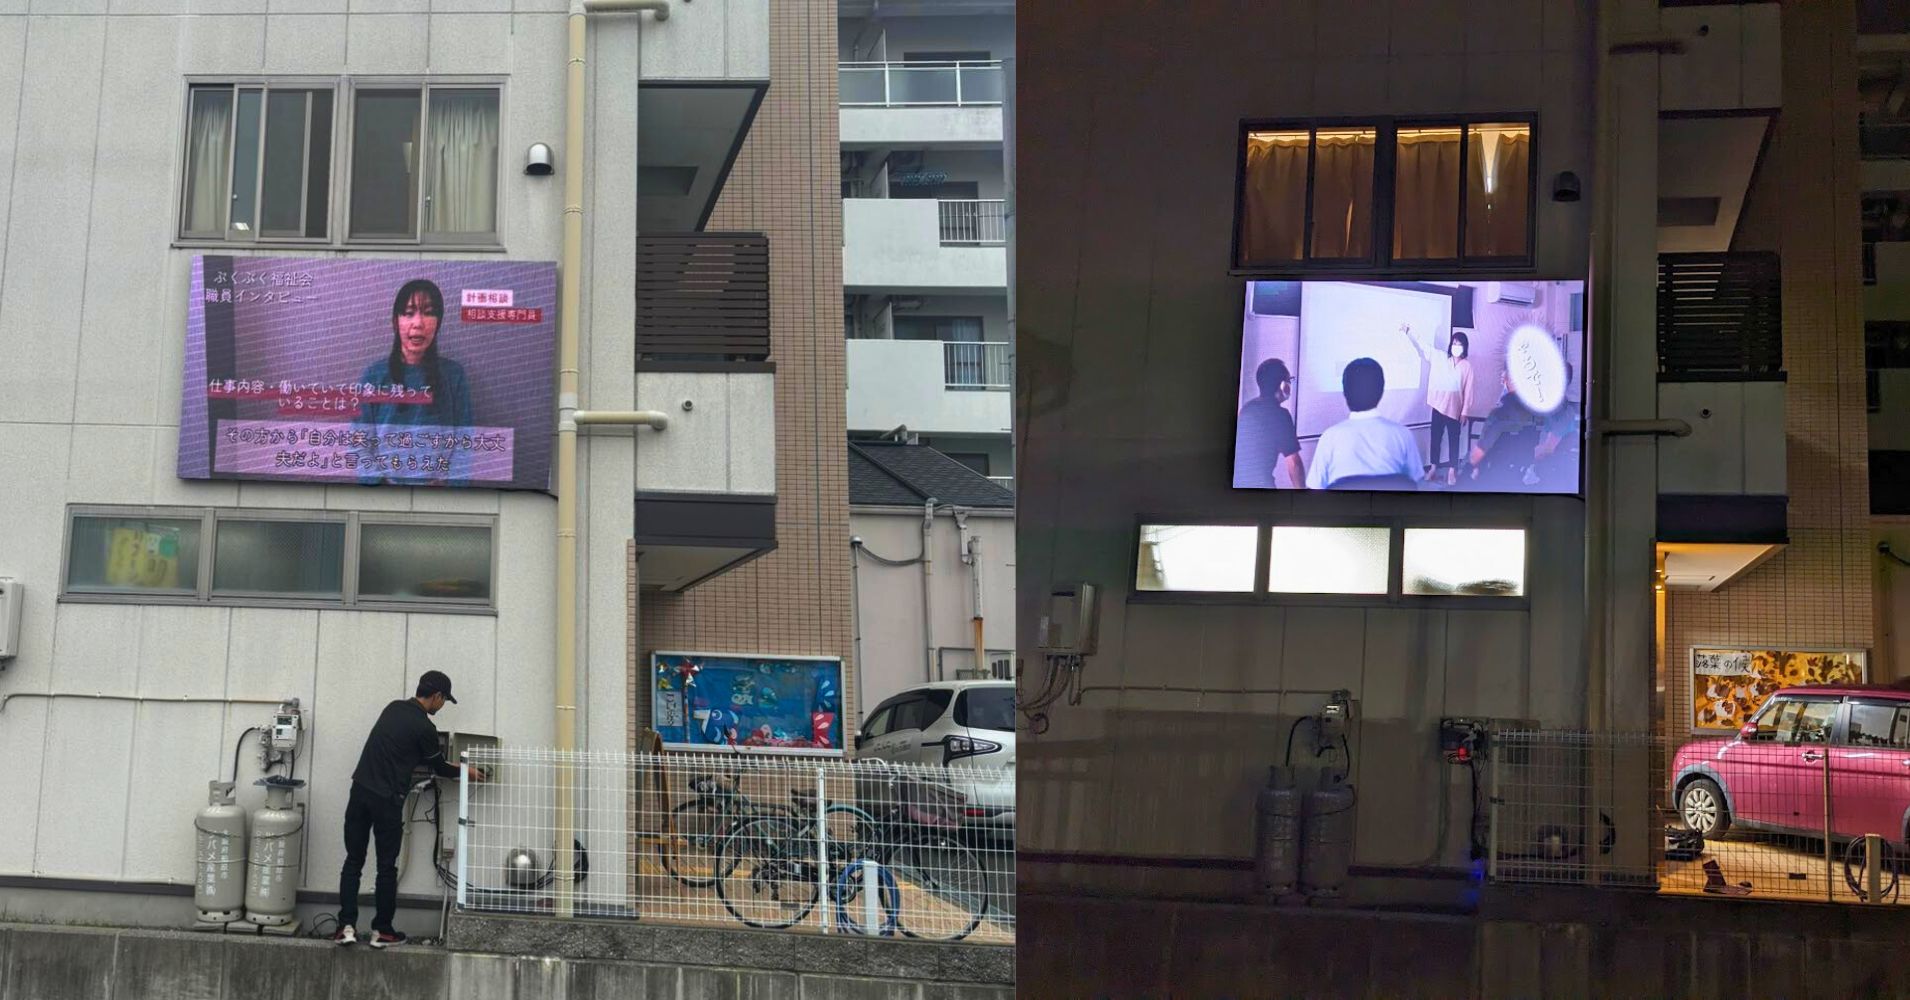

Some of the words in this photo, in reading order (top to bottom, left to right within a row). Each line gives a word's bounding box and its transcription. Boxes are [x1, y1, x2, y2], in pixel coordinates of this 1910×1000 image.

[205, 288, 319, 303] 職員インタビュー
[466, 292, 509, 304] 計画相談
[467, 308, 537, 320] 相談支援専門員
[209, 379, 432, 399] 仕事内容・働いていて印象に残って
